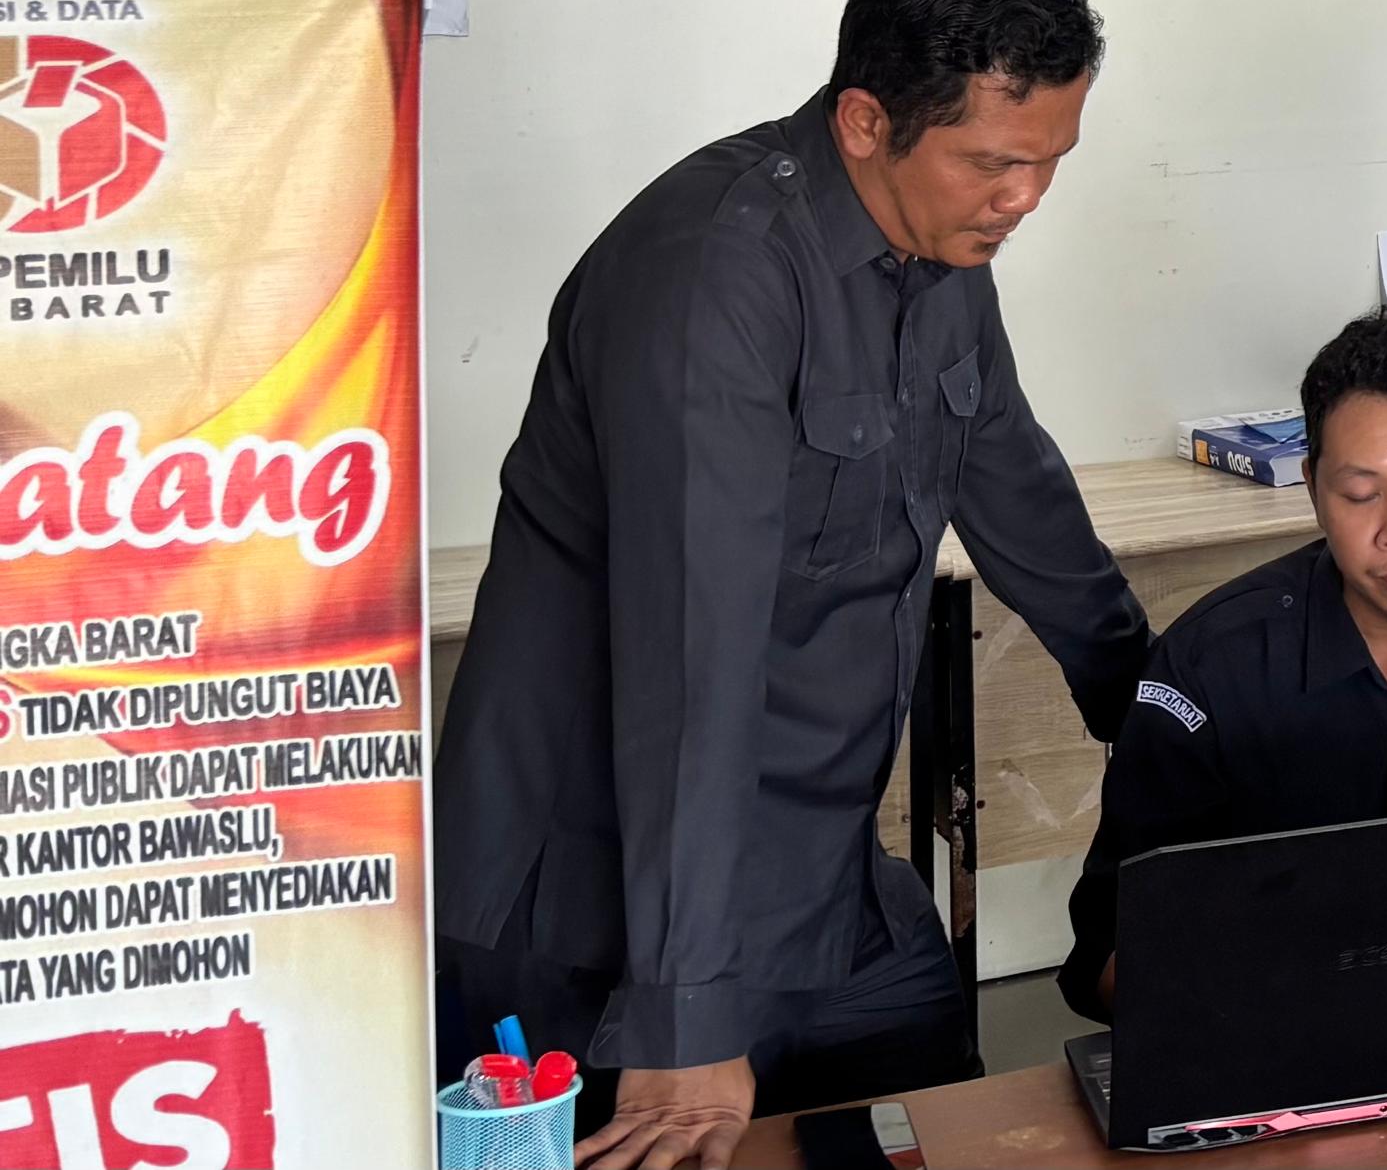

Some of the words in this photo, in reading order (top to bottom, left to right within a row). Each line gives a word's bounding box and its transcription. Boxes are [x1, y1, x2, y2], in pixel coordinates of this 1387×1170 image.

[24, 0, 47, 21] &
[57, 0, 143, 21] DATA
[10, 290, 170, 320] BARAT
[85, 614, 197, 661] BARAT
[19, 690, 120, 735] TIDAK
[130, 675, 299, 726] DIPUNGUT
[305, 667, 399, 709] BIAYA
[1142, 686, 1203, 726] SEKRETARIAT
[62, 755, 165, 808] PUBLIK
[170, 746, 257, 797] DAPAT
[264, 734, 422, 787] MELAKUKAN
[16, 822, 132, 868] KANTOR
[139, 807, 280, 862] BAWASLU,
[105, 876, 193, 928] DAPAT
[200, 858, 390, 917] MENYEDIAKAN
[38, 948, 115, 996] YANG
[123, 933, 249, 989] DIMOHON
